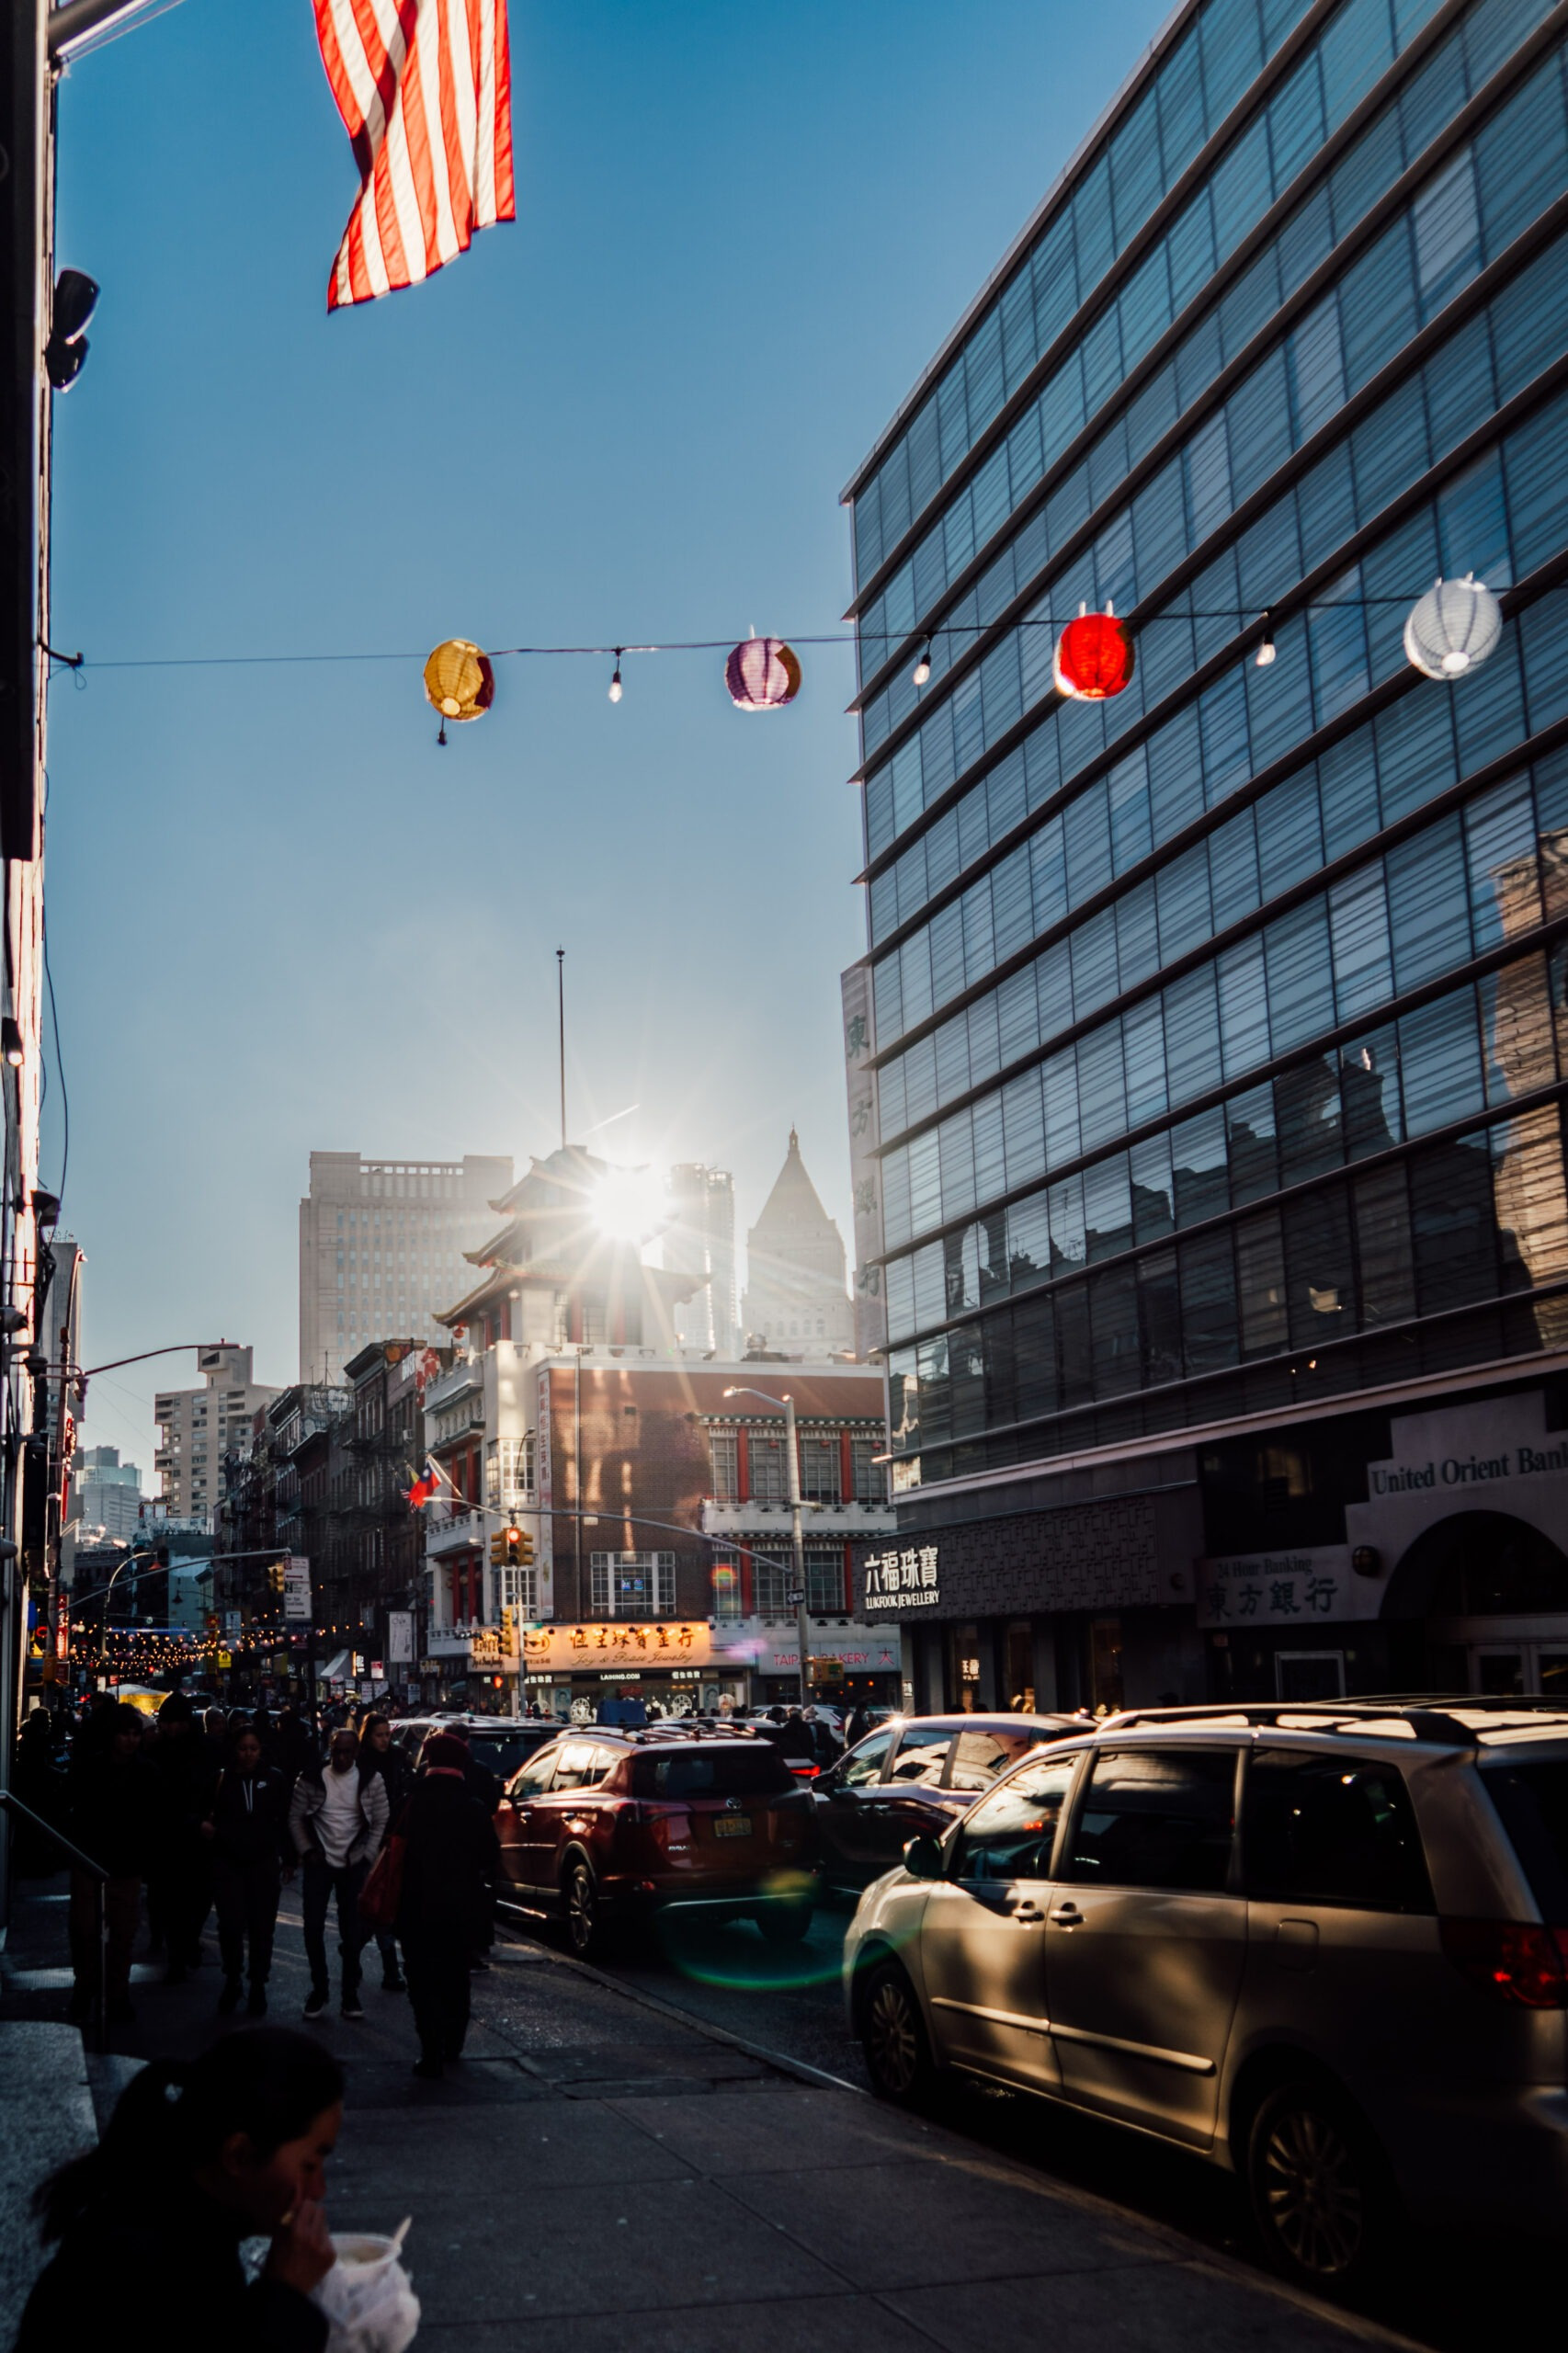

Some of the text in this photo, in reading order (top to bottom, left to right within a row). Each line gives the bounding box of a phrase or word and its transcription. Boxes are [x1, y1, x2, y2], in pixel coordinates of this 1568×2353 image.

[846, 1015, 880, 1299] 東方銀行
[1371, 1462, 1436, 1495] United
[1441, 1453, 1509, 1484] Orient
[864, 1545, 938, 1594] 六福珠寶
[1218, 1557, 1312, 1579] 24 Hour Banking
[866, 1590, 940, 1609] LUKFOOK JEWELLERY
[1206, 1577, 1338, 1621] 東方銀行
[572, 1651, 693, 1666] Joy & Peace Jewelry
